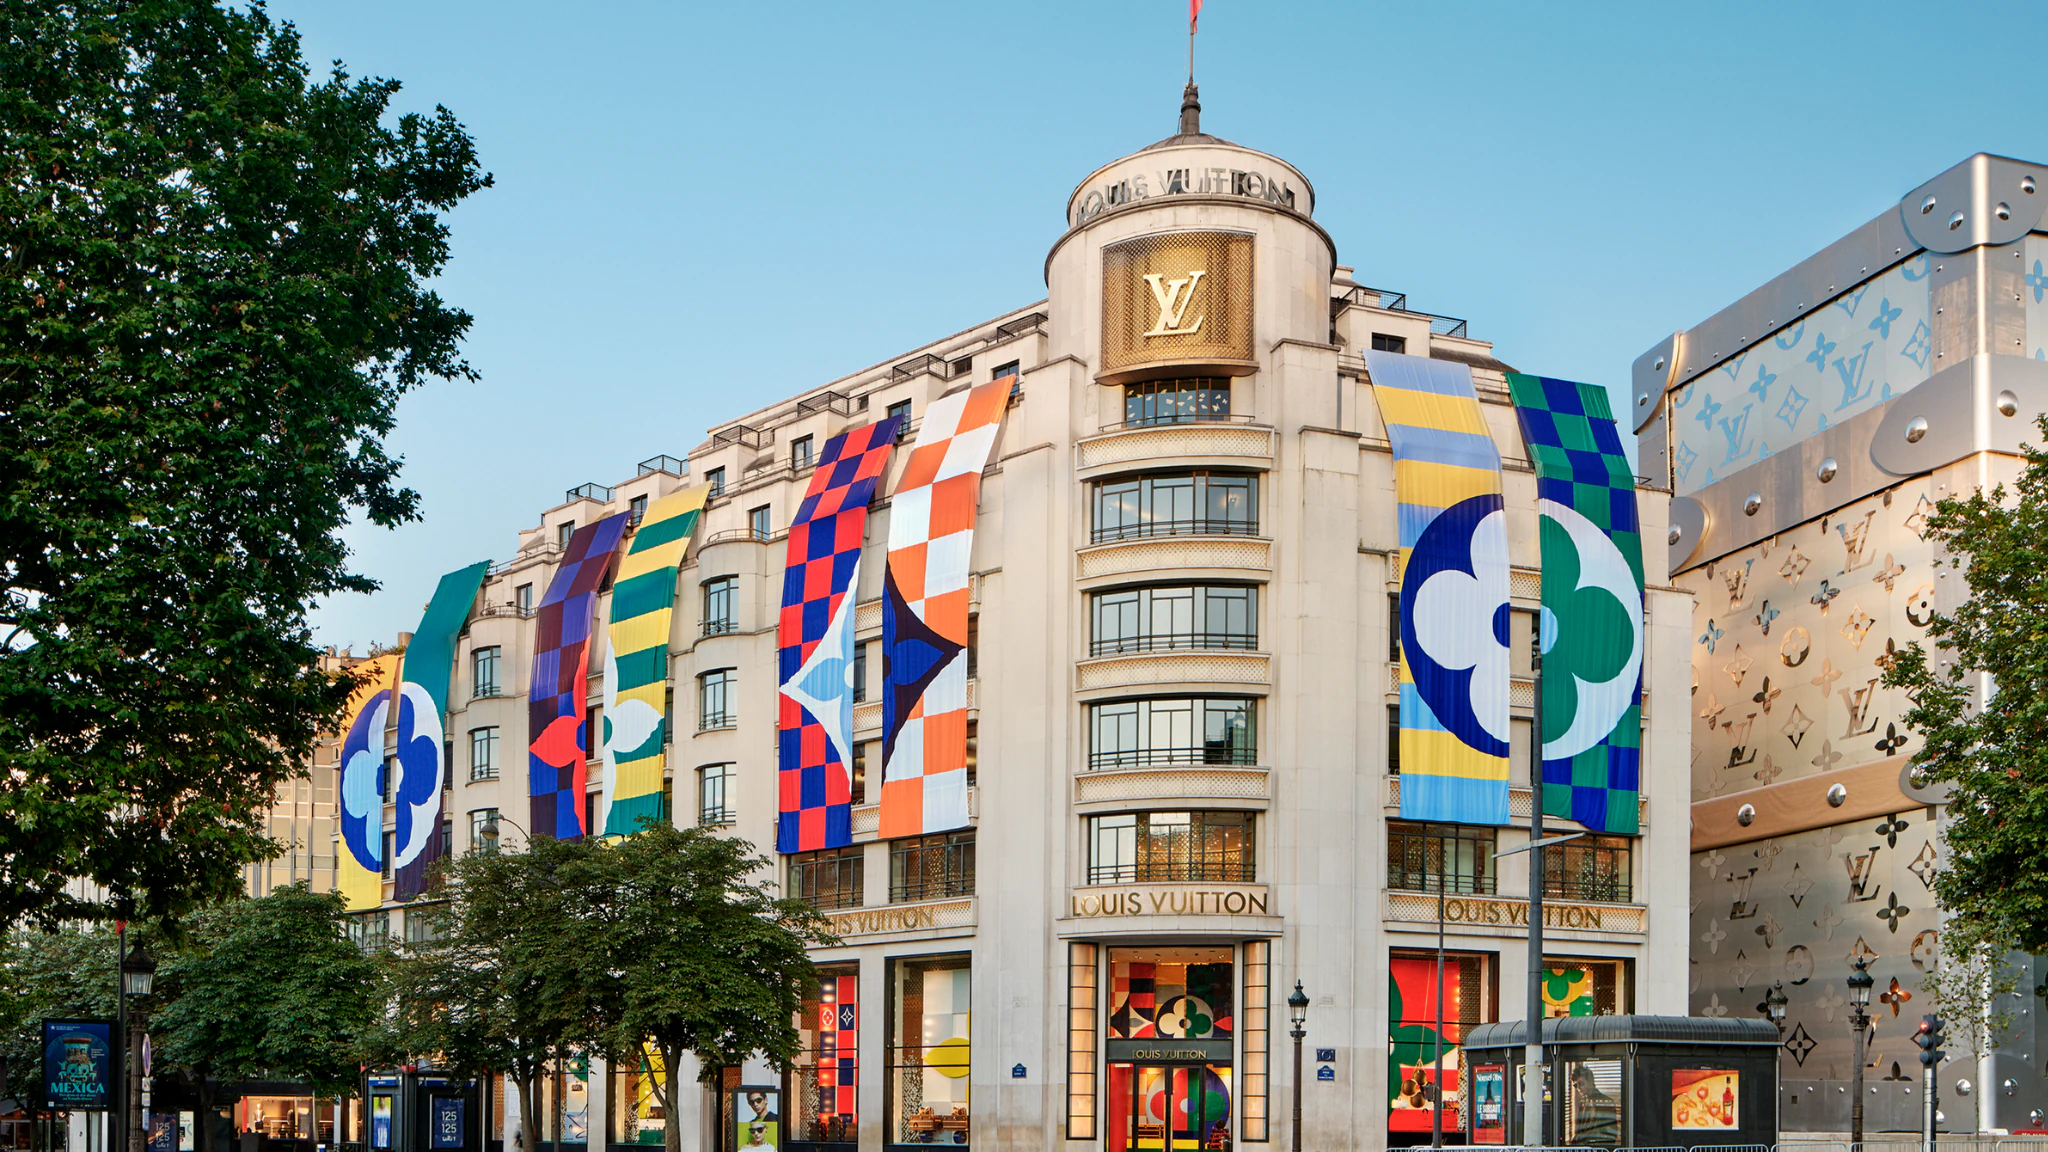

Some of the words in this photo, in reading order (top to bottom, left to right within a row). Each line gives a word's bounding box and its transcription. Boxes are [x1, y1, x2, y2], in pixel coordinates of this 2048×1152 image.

[1077, 173, 1149, 225] LOUIS
[1156, 167, 1287, 206] VUITTON
[1072, 891, 1142, 917] LOUIS
[1149, 891, 1267, 915] VUITTON
[856, 908, 935, 933] VUITTON
[1132, 1050, 1160, 1059] LOUIS
[1163, 1050, 1207, 1059] VUITTON
[51, 1083, 105, 1093] MEXICA
[442, 1111, 457, 1121] 125
[155, 1122, 170, 1131] 125
[442, 1124, 457, 1133] 125
